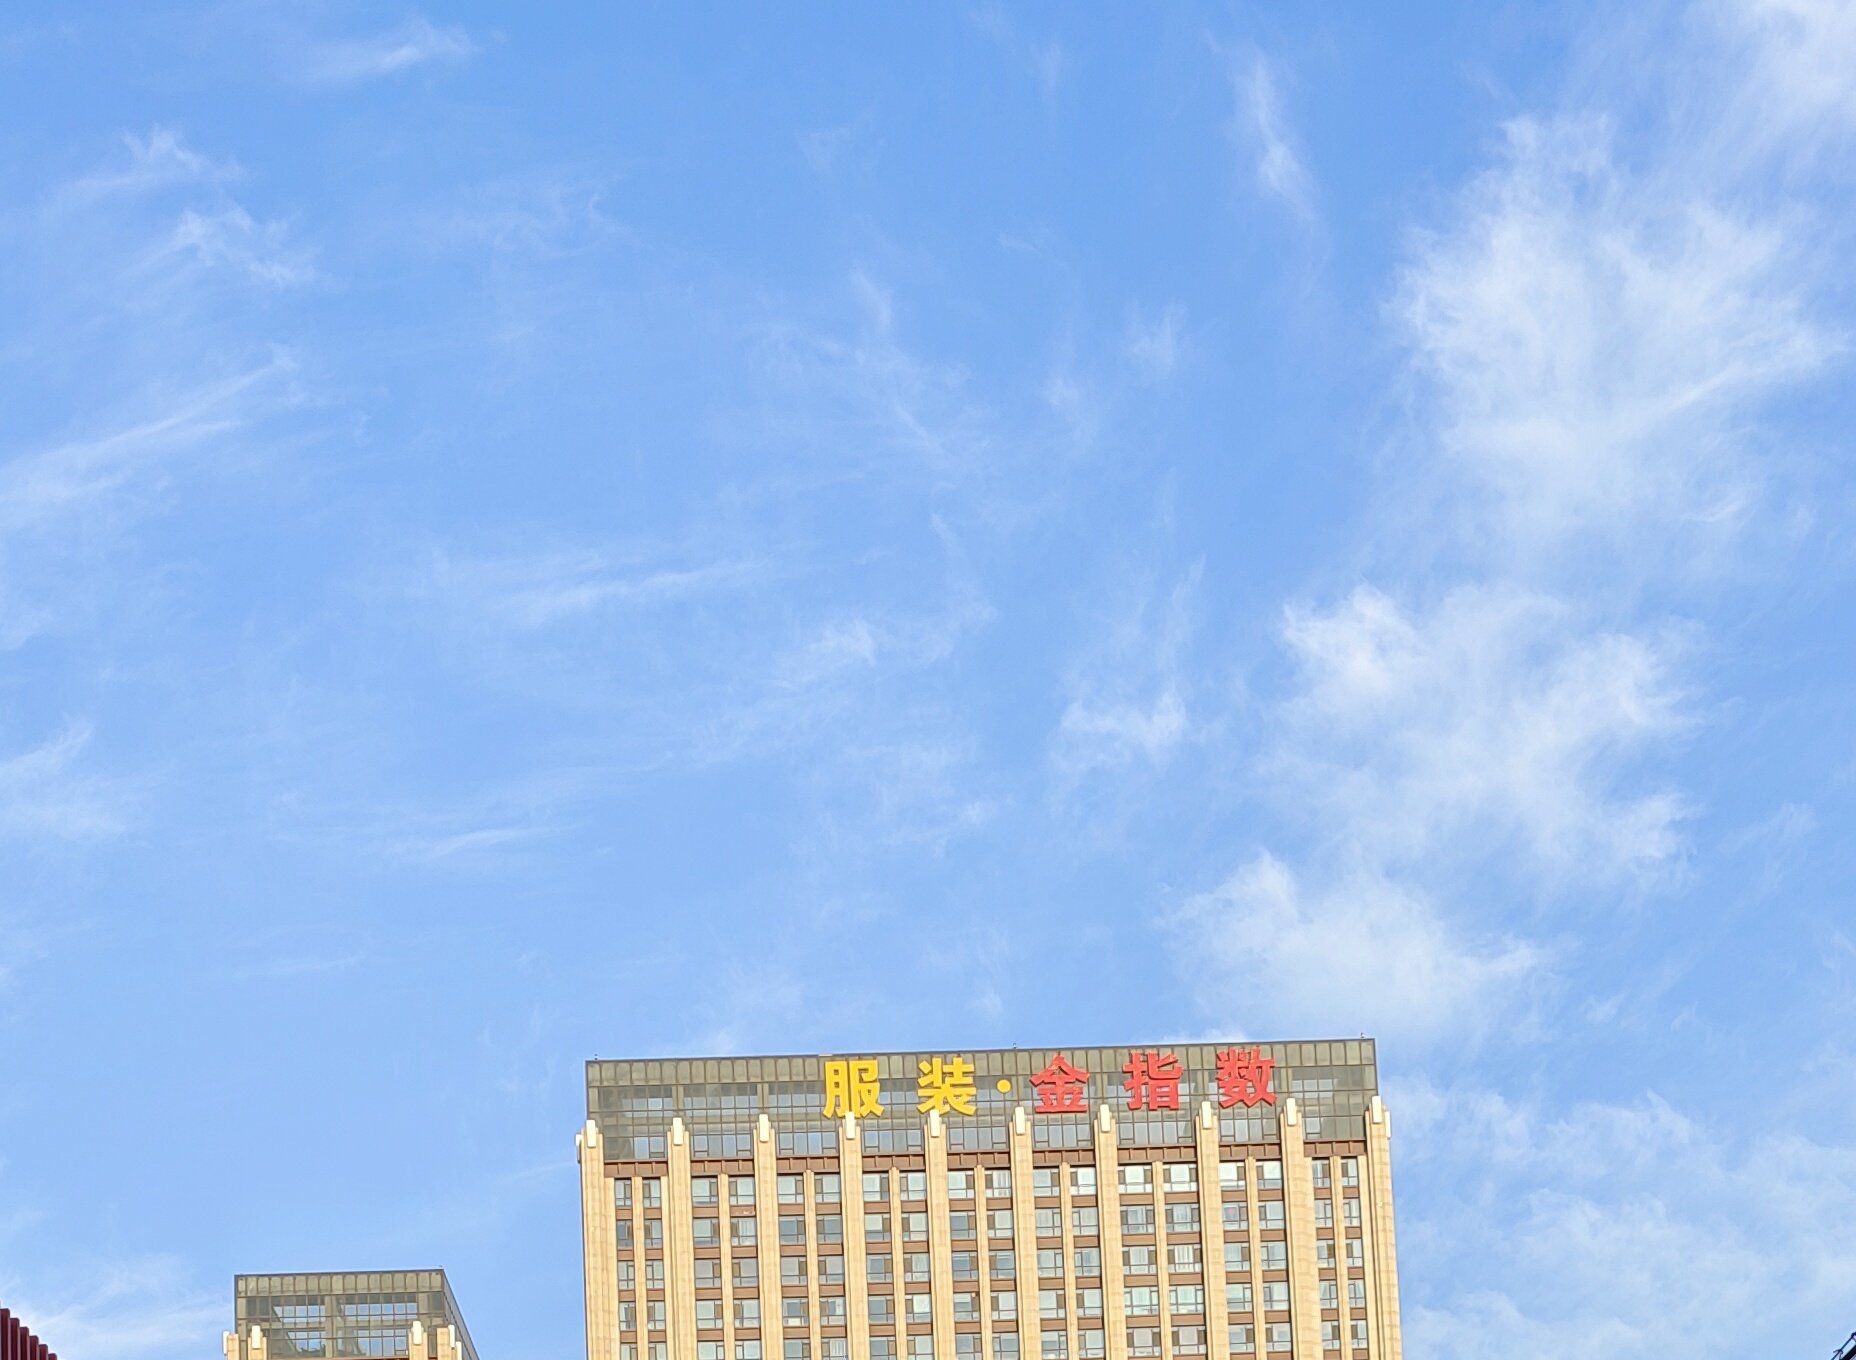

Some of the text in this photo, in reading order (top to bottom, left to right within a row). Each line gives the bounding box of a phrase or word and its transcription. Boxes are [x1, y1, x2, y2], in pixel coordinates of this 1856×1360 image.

[823, 1047, 1276, 1118] 服装·金指数
